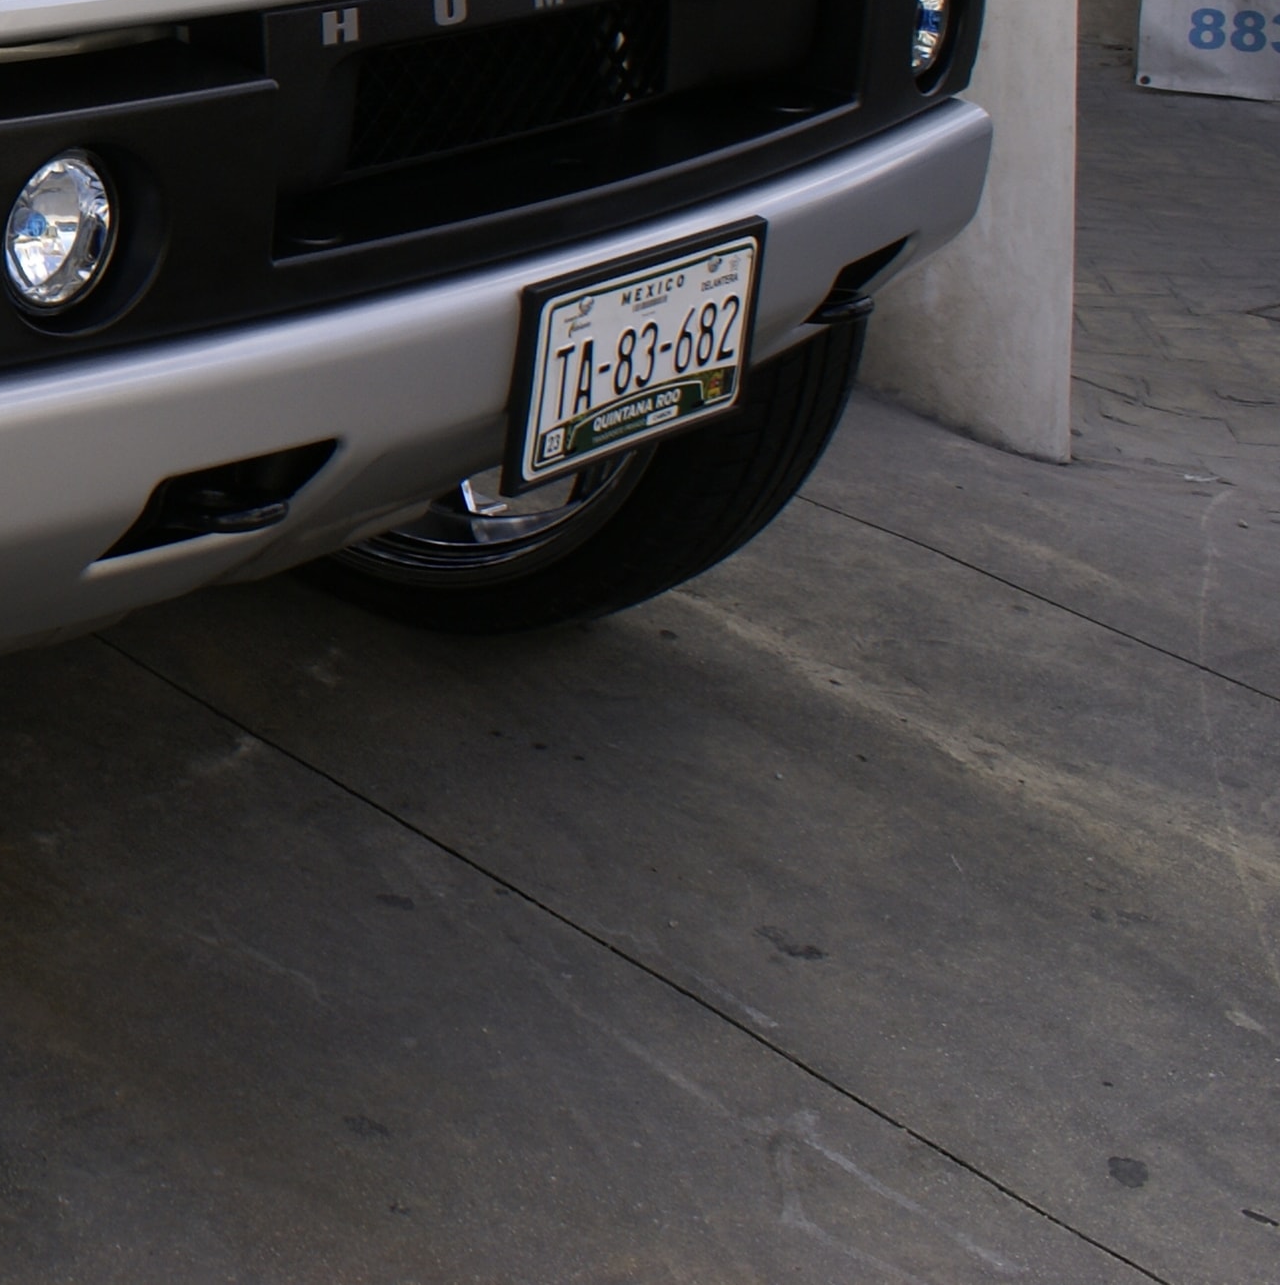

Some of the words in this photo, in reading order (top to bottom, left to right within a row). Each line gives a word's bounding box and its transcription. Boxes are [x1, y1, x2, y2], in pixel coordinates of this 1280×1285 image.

[621, 274, 685, 306] MEXICO
[556, 294, 740, 420] TA-83-682
[593, 398, 654, 432] QUINTANA
[656, 388, 682, 410] ROO
[546, 434, 561, 454] 23
